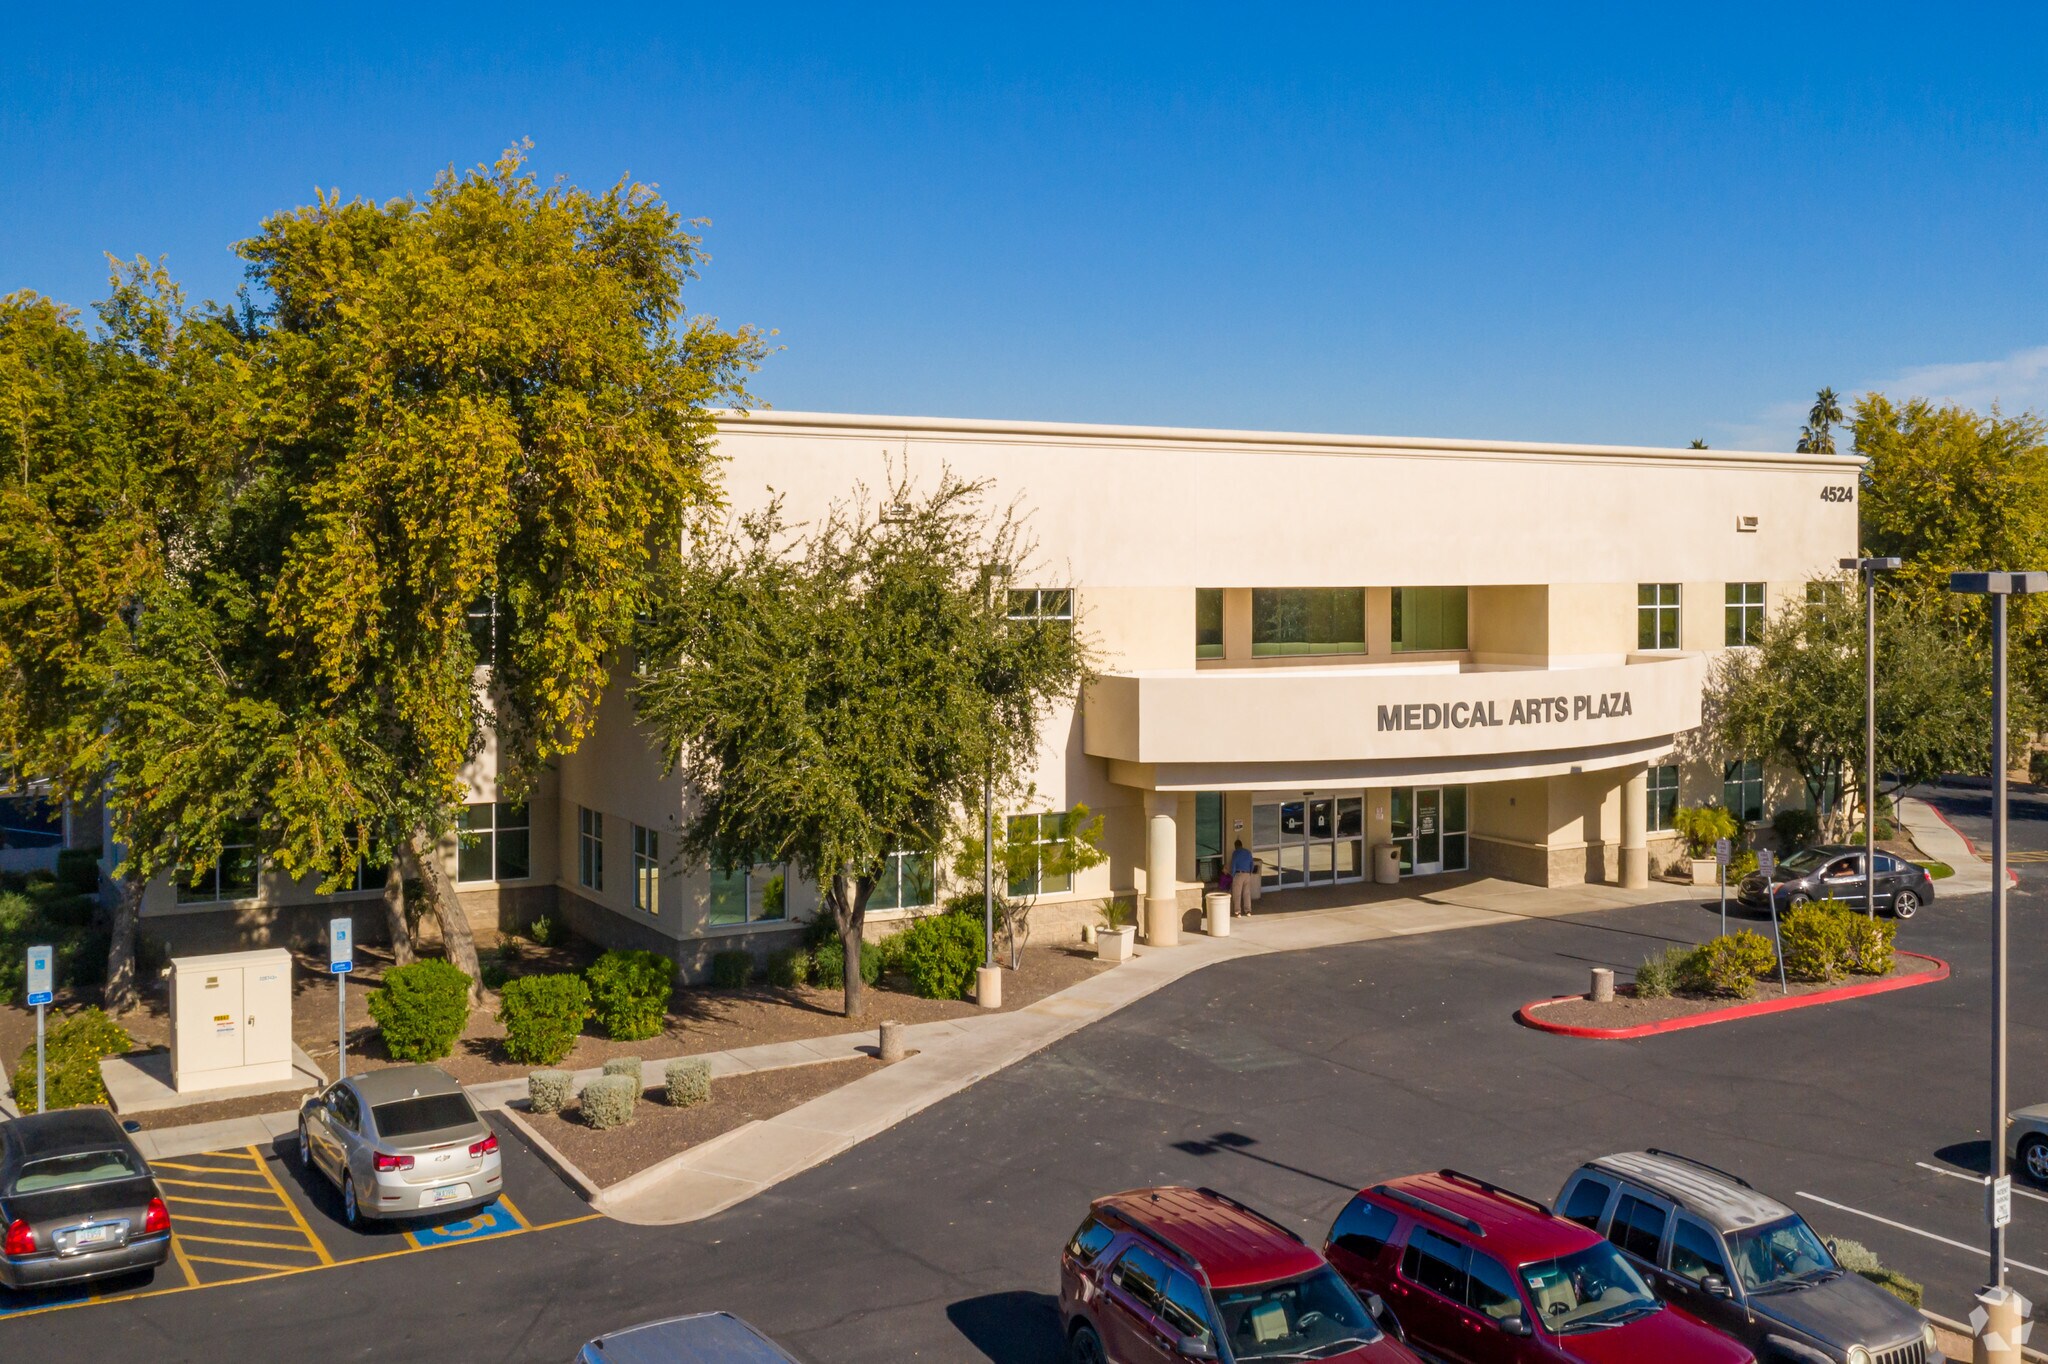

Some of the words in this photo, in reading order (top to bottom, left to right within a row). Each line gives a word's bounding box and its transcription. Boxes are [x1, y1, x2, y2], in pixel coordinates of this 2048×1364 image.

[1820, 486, 1853, 503] 4524
[1377, 700, 1504, 732] MEDICAL
[1508, 696, 1569, 726] ARTS
[1573, 691, 1633, 721] PLAZA
